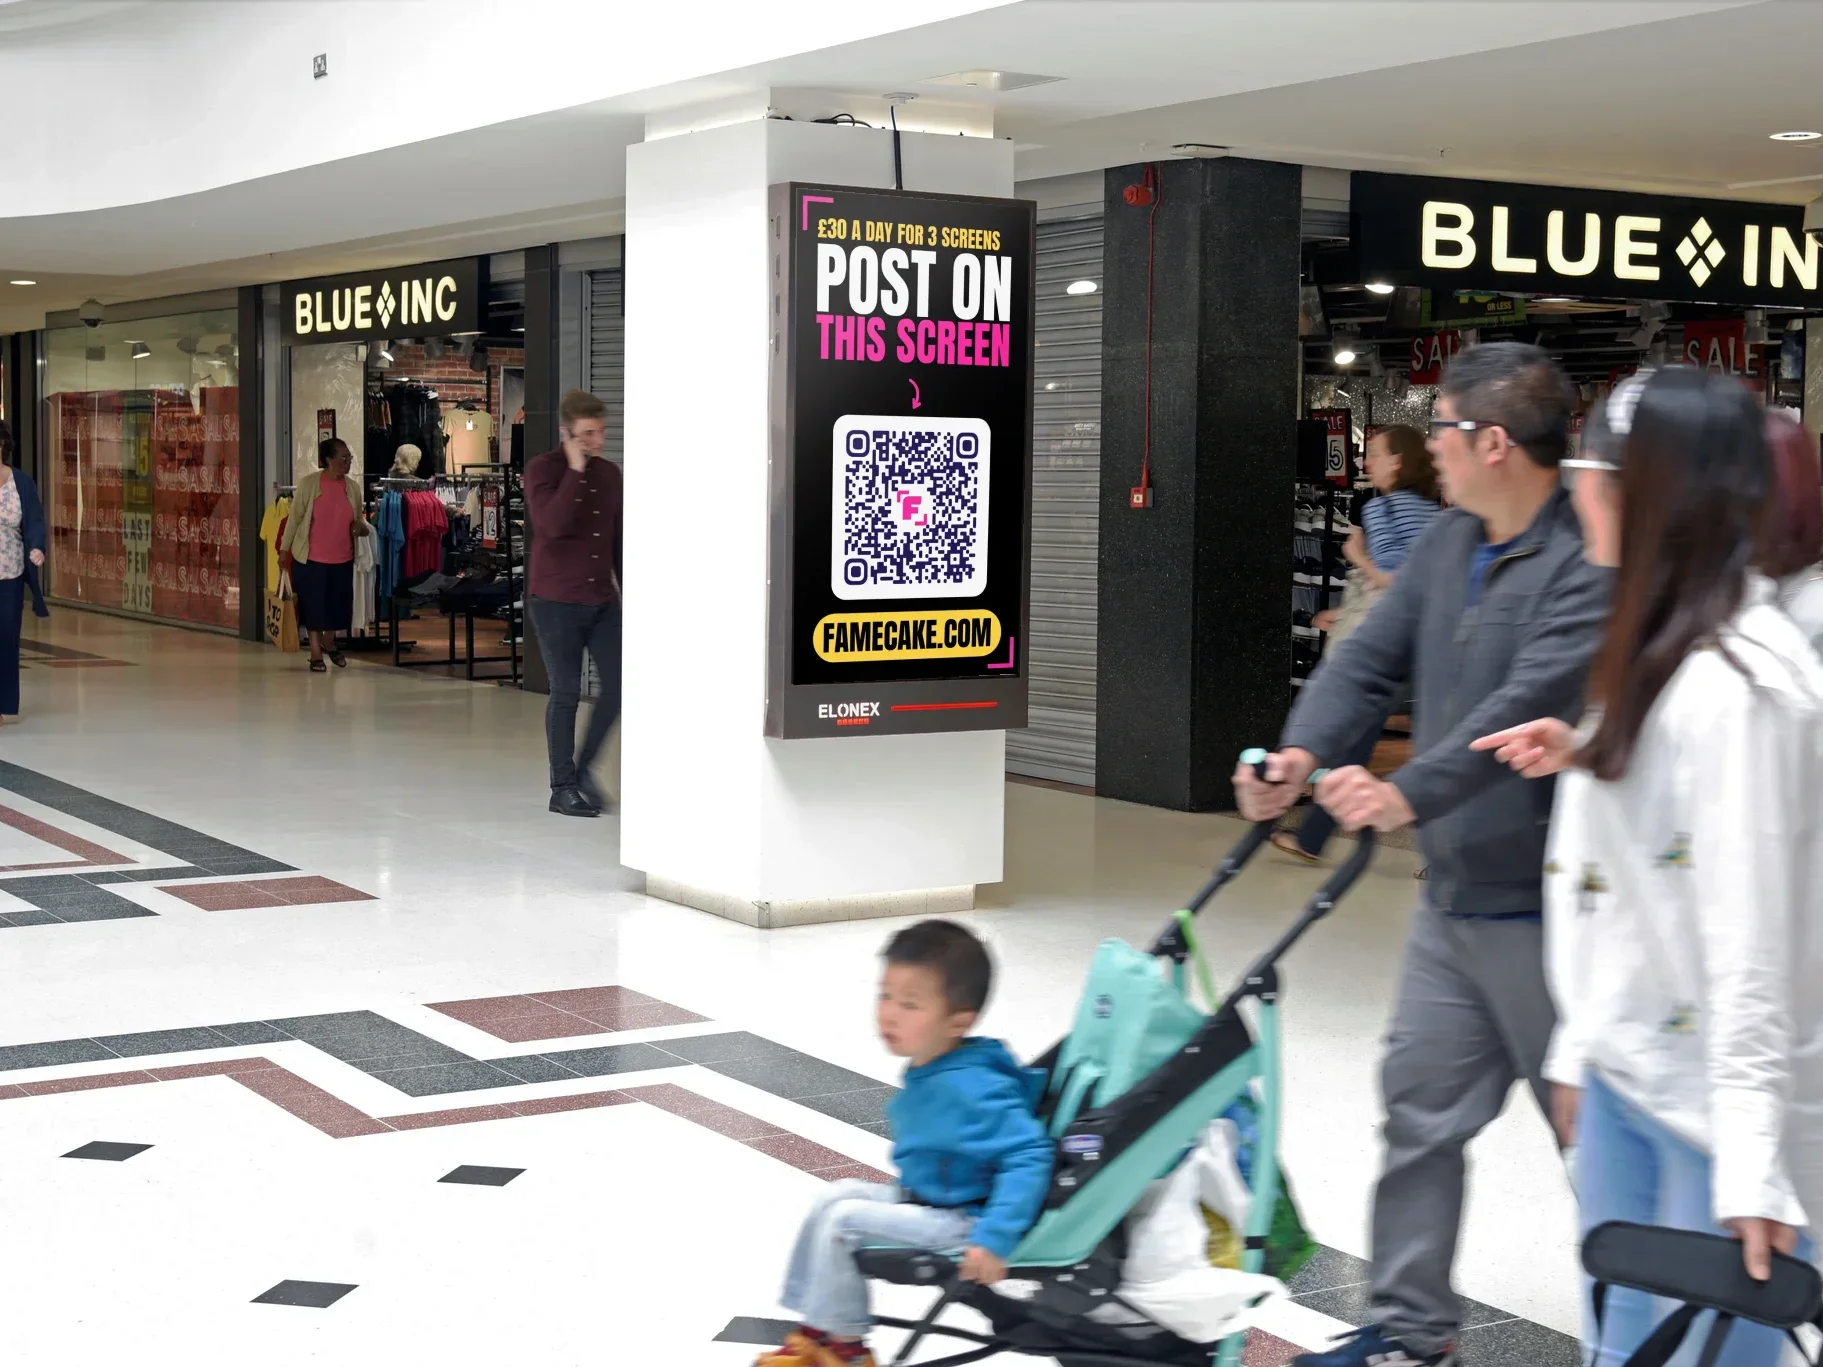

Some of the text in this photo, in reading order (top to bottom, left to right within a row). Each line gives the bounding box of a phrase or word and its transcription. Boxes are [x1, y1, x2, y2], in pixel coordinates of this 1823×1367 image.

[817, 217, 1001, 251] £30 A DAY FOR 3 SCREENS
[1421, 200, 1661, 281] BLUE
[816, 242, 1012, 322] POST ON
[295, 275, 457, 335] BLUE INC
[1496, 301, 1512, 311] LESS
[816, 314, 1010, 367] THIS SCREEN
[1411, 334, 1454, 372] SAL
[1687, 336, 1759, 376] SALE
[1314, 415, 1343, 430] ALE
[1325, 439, 1344, 471] 5
[123, 517, 150, 542] LAST
[127, 550, 147, 575] FEW
[123, 582, 150, 610] DAYS
[823, 617, 992, 653] FAMECAKE.COM
[818, 702, 880, 719] ELONEX
